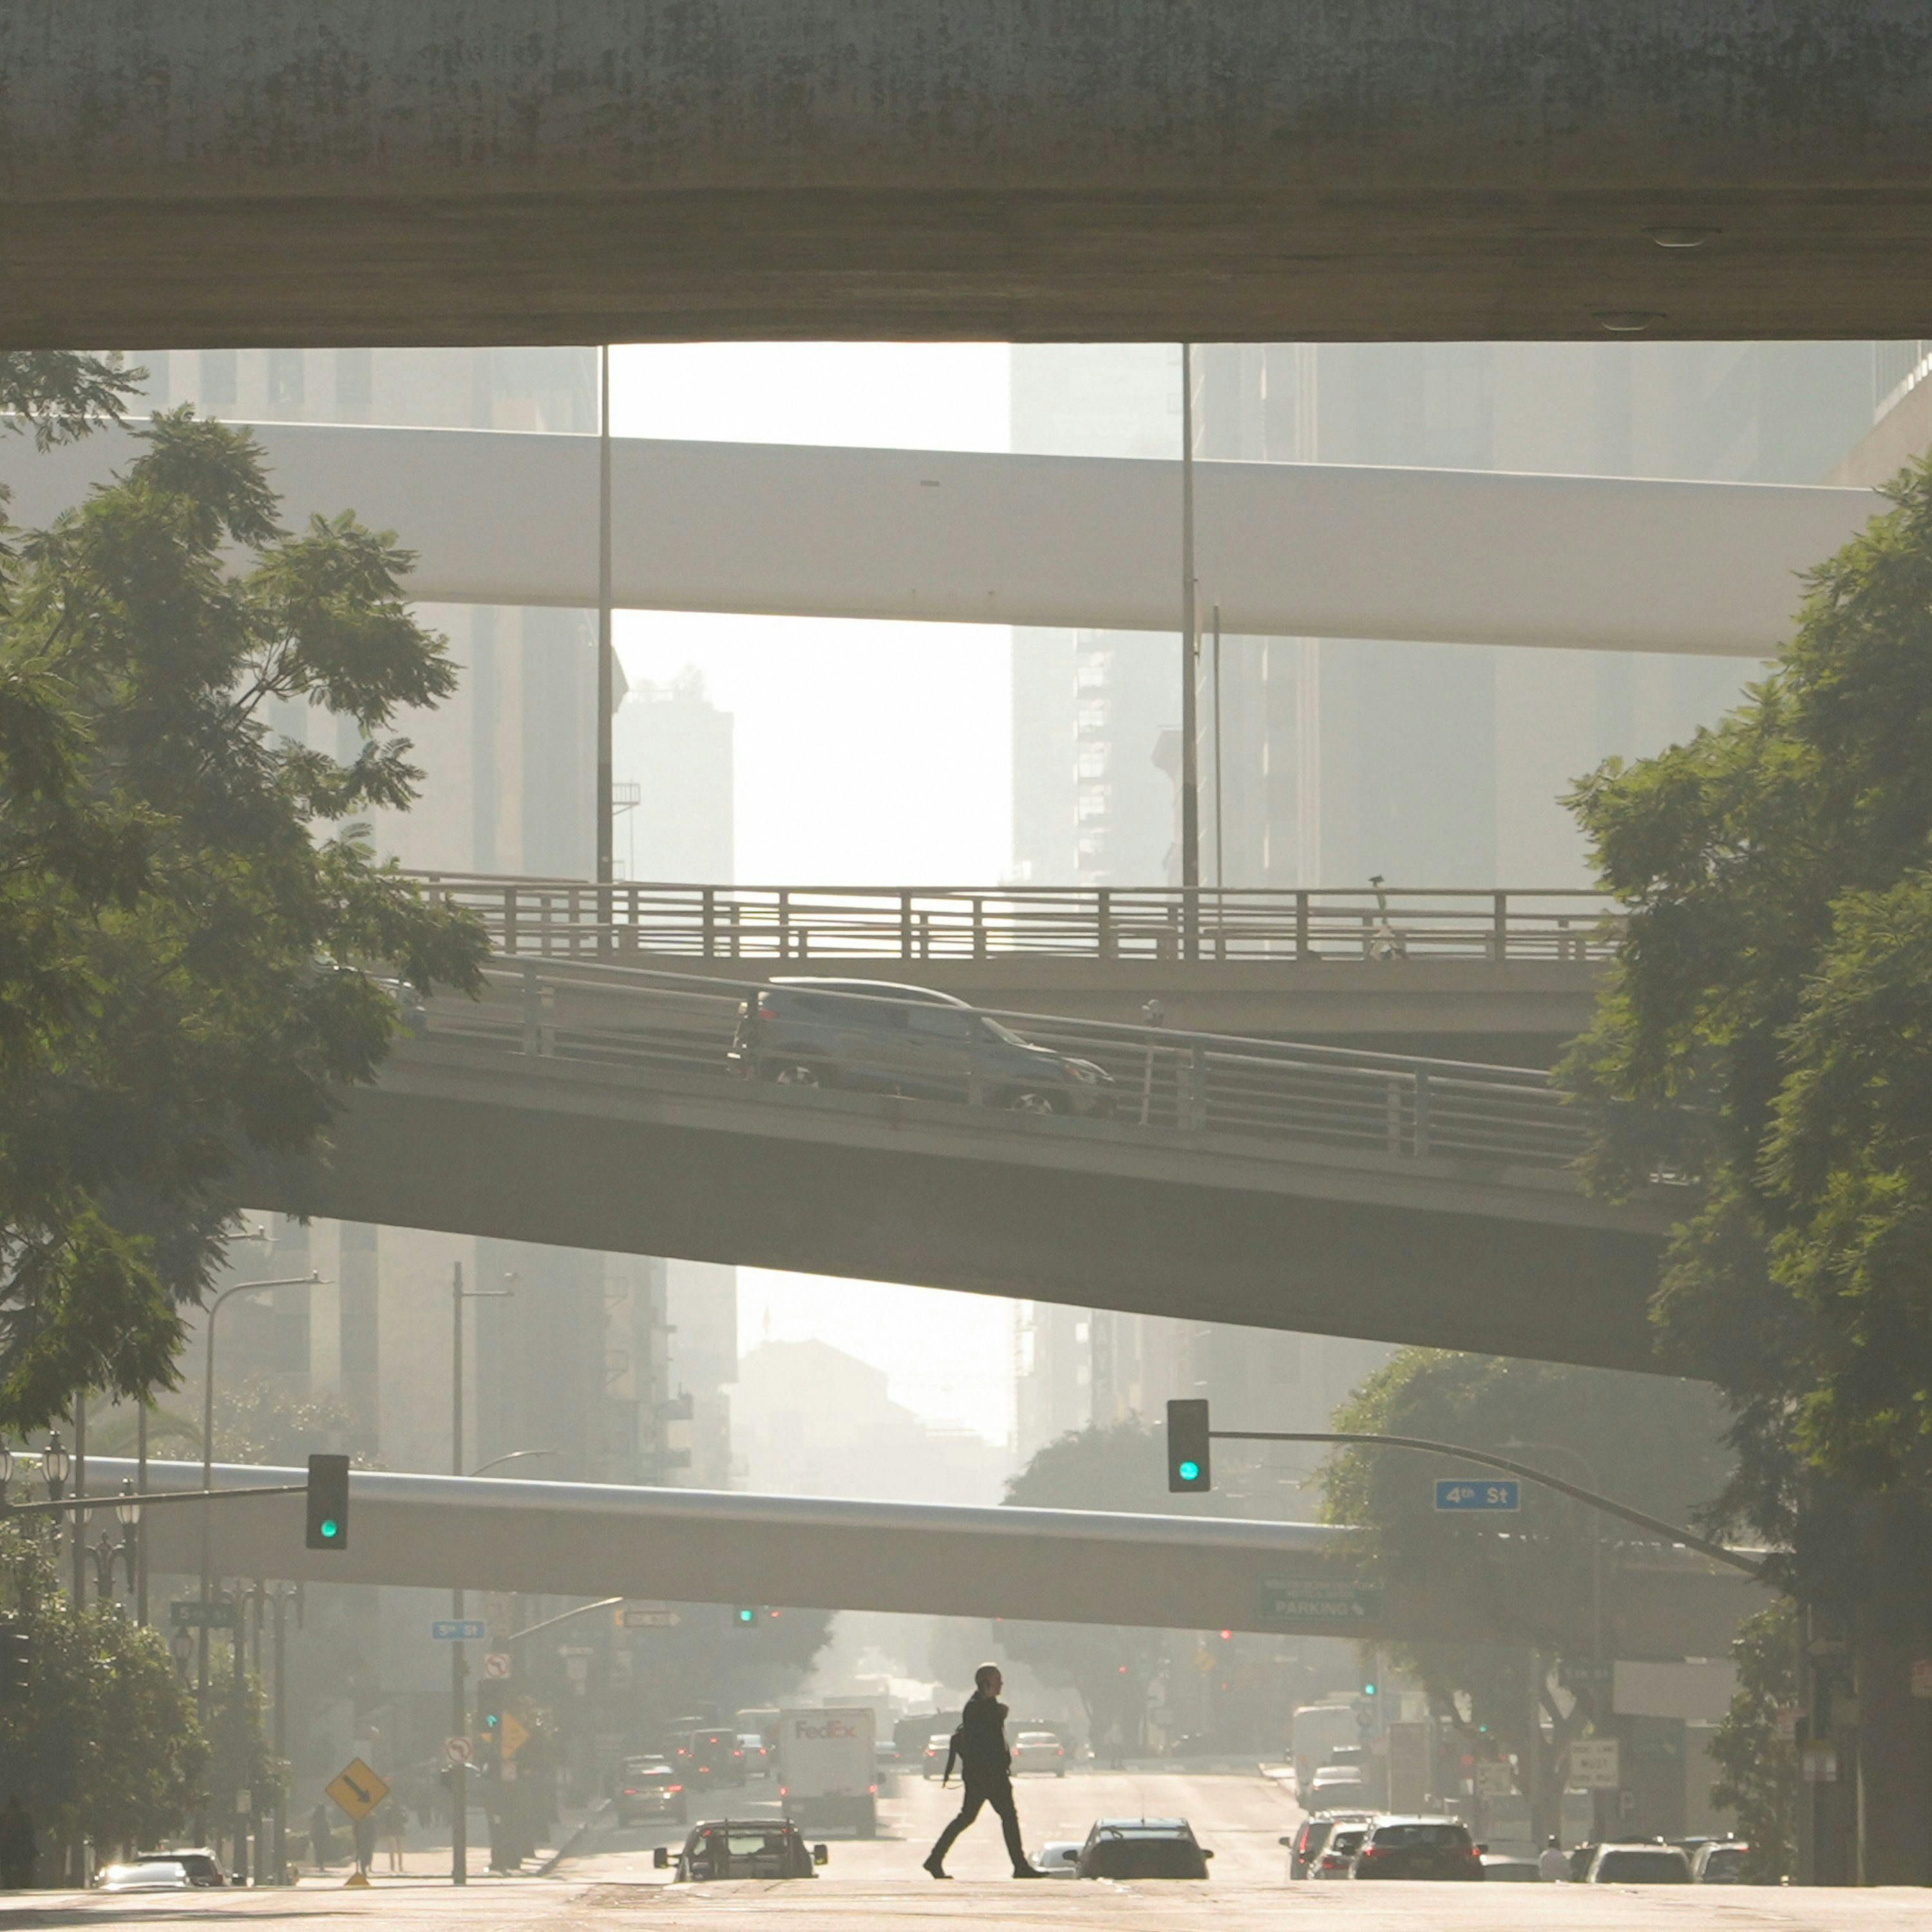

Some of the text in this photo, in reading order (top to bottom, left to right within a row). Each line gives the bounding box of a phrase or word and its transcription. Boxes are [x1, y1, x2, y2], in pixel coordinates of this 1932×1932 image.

[1446, 1486, 1508, 1504] 4th St
[1275, 1600, 1349, 1615] PARKING
[463, 1624, 478, 1636] St
[795, 1720, 855, 1739] FedEx
